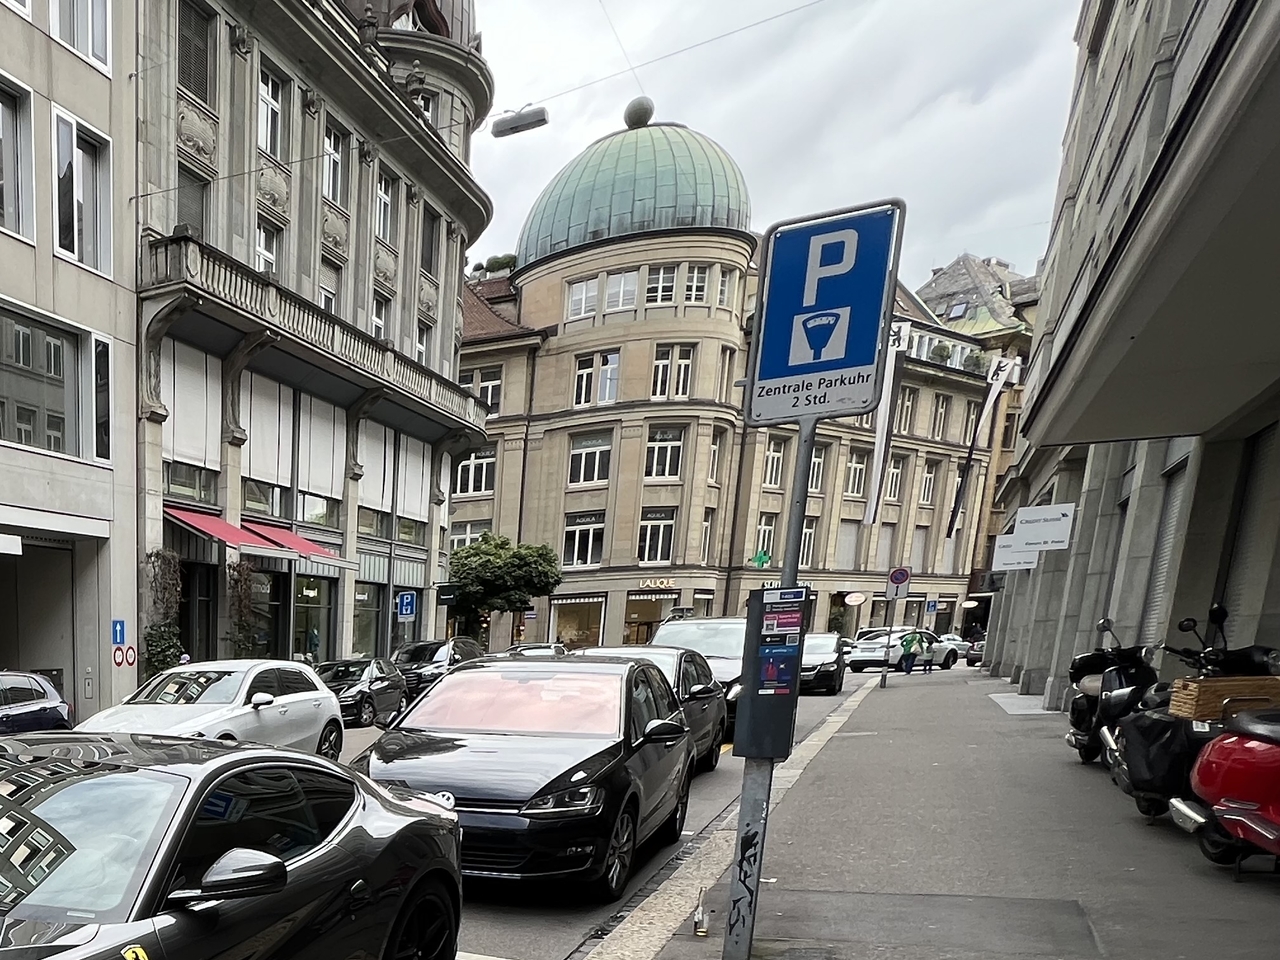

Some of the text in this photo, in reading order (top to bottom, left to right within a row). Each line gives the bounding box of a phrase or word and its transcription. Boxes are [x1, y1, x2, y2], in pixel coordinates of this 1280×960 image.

[803, 228, 859, 307] P
[757, 372, 873, 398] Zentrale Parkuhr
[791, 392, 830, 408] 2 Std.
[575, 515, 597, 524] AQUILA
[646, 512, 666, 520] AQUILA
[639, 578, 676, 589] LALIQUE
[403, 594, 412, 606] P
